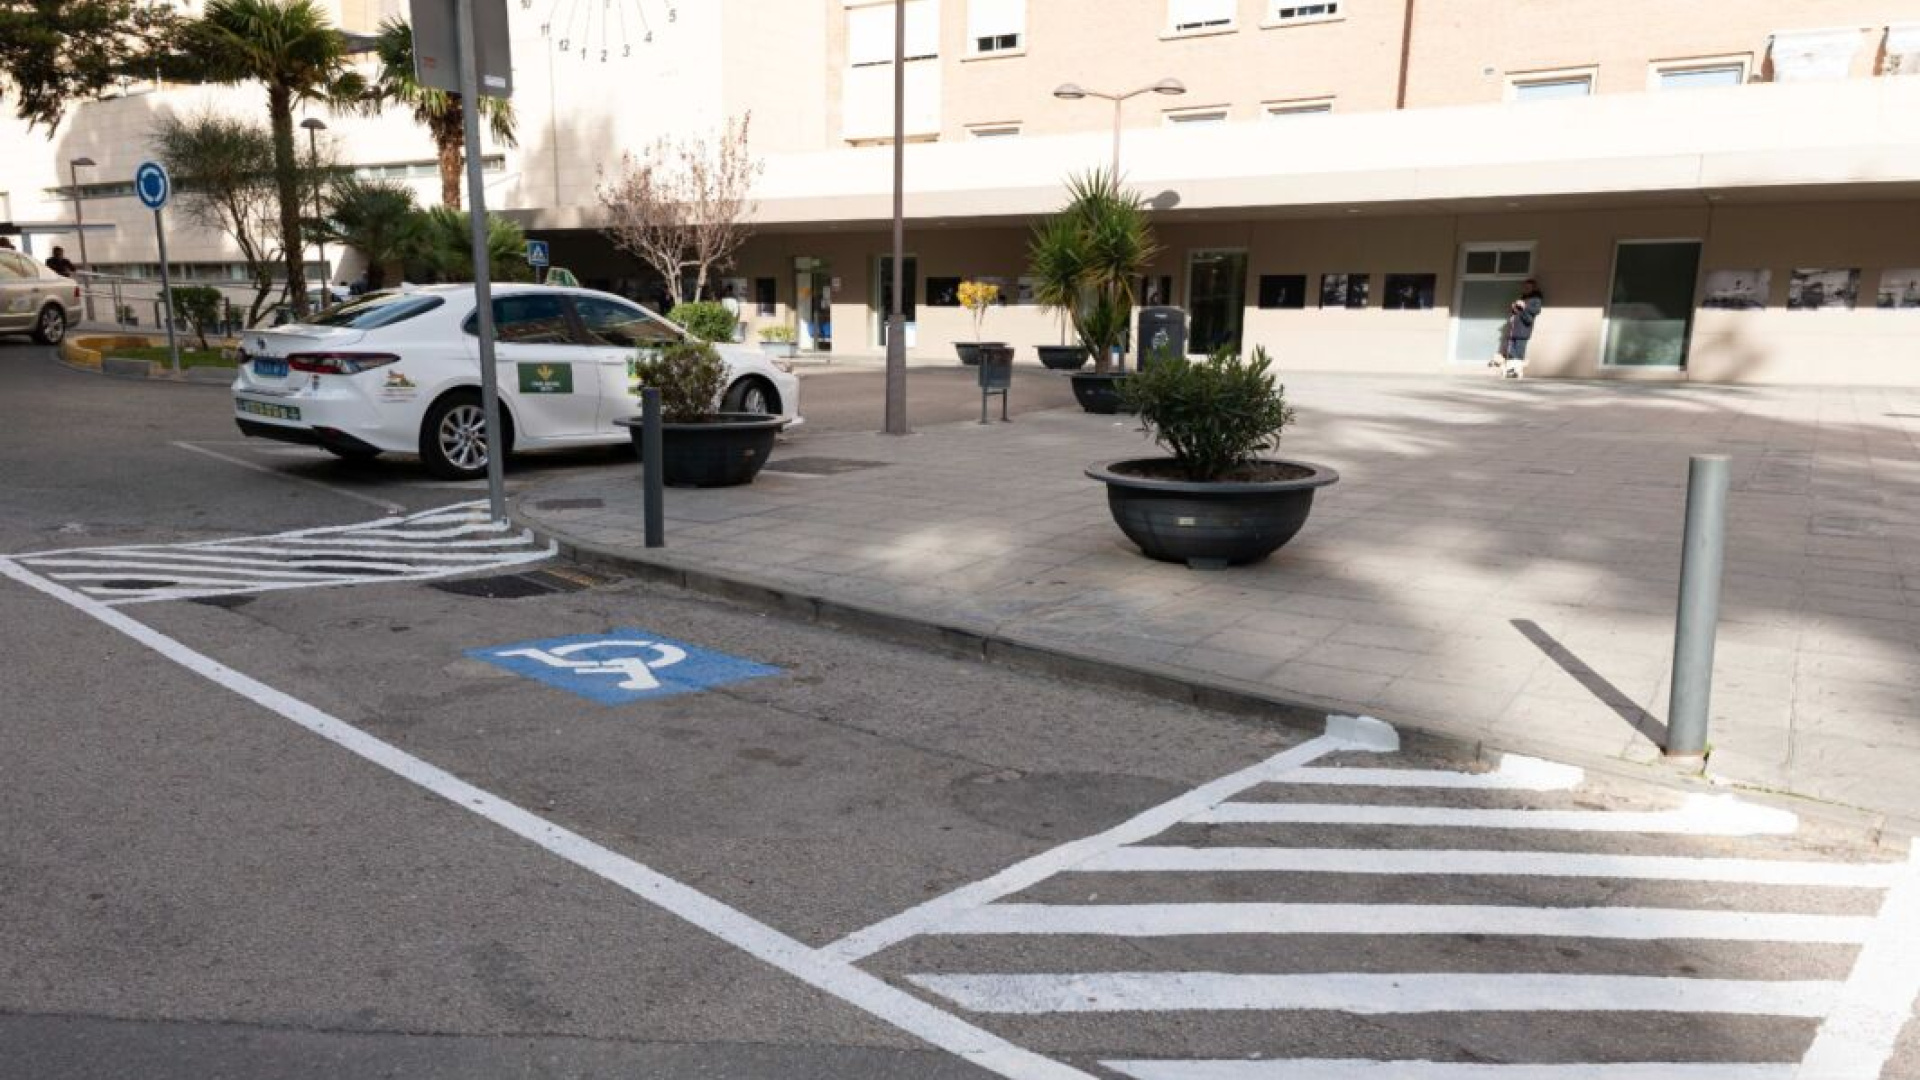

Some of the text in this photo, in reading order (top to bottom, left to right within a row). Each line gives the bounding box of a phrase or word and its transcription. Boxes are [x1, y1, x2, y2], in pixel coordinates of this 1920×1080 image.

[669, 9, 676, 22] 5
[540, 23, 550, 35] 11
[644, 31, 652, 43] 4
[559, 39, 570, 51] 12
[623, 44, 630, 57] 3
[601, 49, 607, 62] 2
